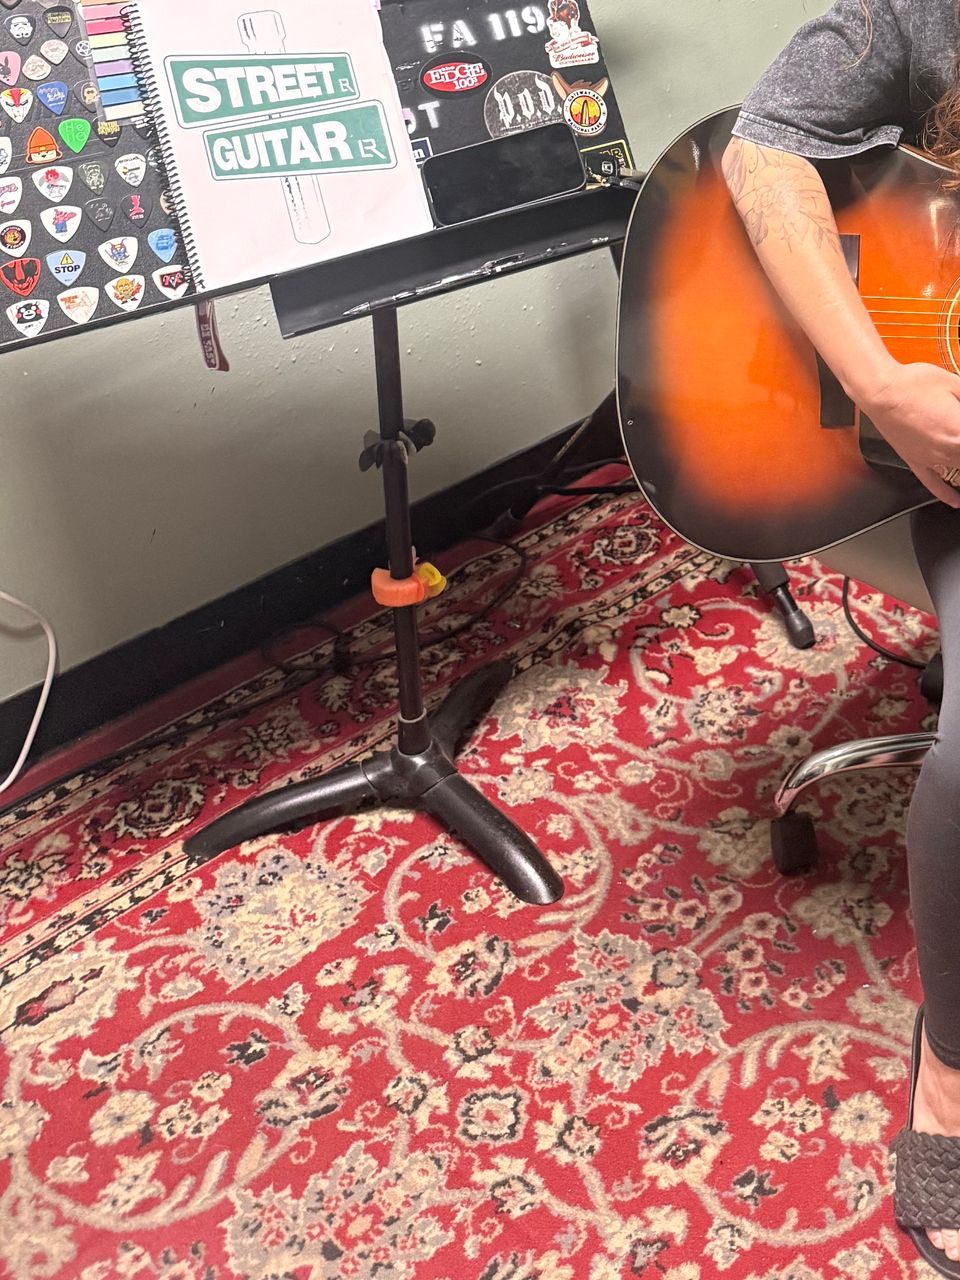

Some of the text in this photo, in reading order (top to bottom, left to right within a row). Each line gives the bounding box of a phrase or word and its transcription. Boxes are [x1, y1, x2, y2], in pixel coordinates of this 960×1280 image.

[420, 5, 547, 54] FA 119
[182, 62, 336, 114] STREET
[427, 62, 485, 84] EDGE
[212, 120, 354, 171] GUITAR
[54, 264, 81, 274] STOP
